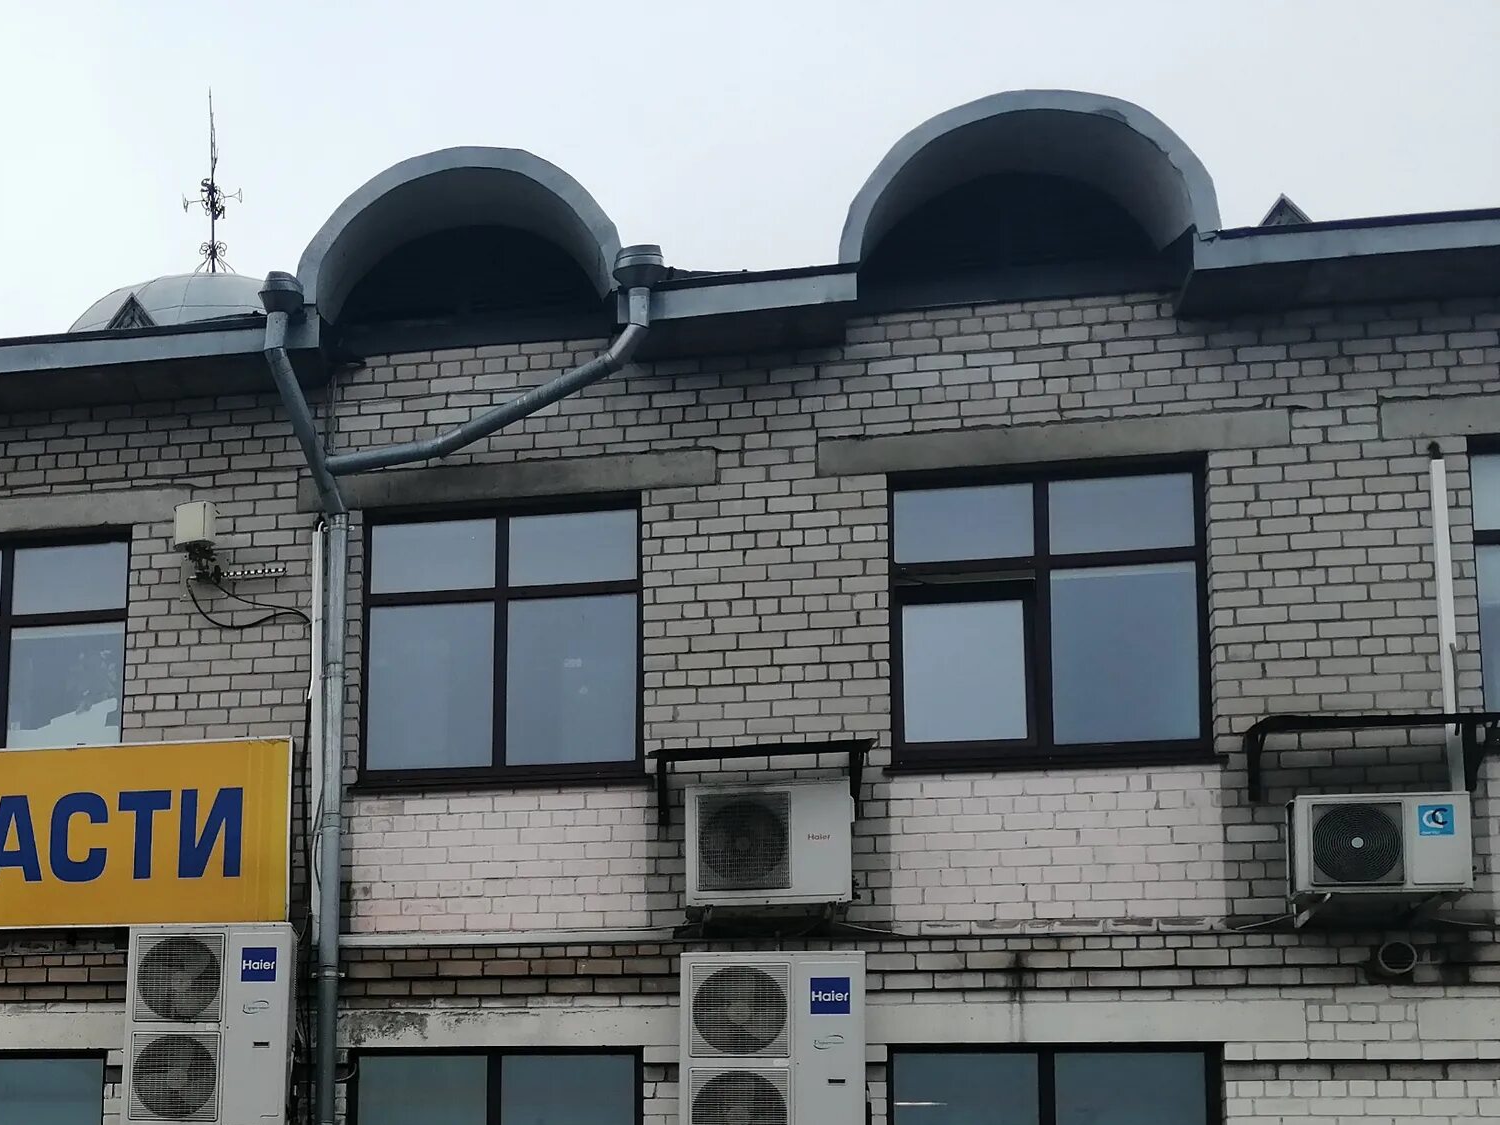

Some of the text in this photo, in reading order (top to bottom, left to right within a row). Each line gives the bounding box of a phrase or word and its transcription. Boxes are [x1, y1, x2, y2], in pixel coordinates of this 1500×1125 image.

[807, 833, 831, 841] Haier
[242, 959, 275, 970] Haier
[811, 990, 849, 1002] Haier
